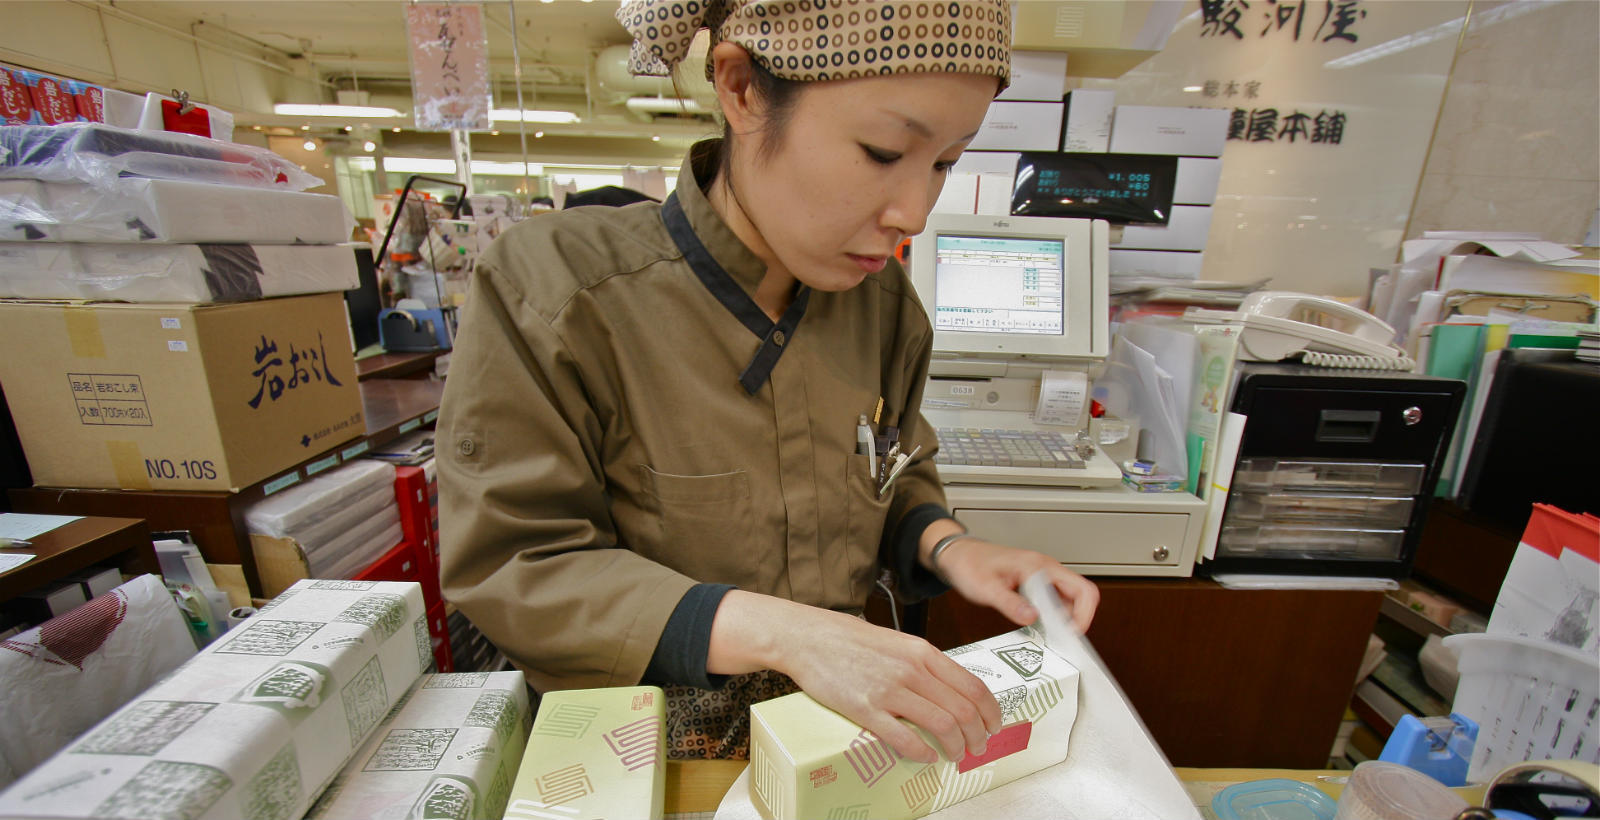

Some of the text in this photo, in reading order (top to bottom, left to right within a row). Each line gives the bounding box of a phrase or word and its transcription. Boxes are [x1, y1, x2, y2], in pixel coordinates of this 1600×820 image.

[73, 381, 93, 392] 品名
[247, 330, 344, 410] 岩おこし
